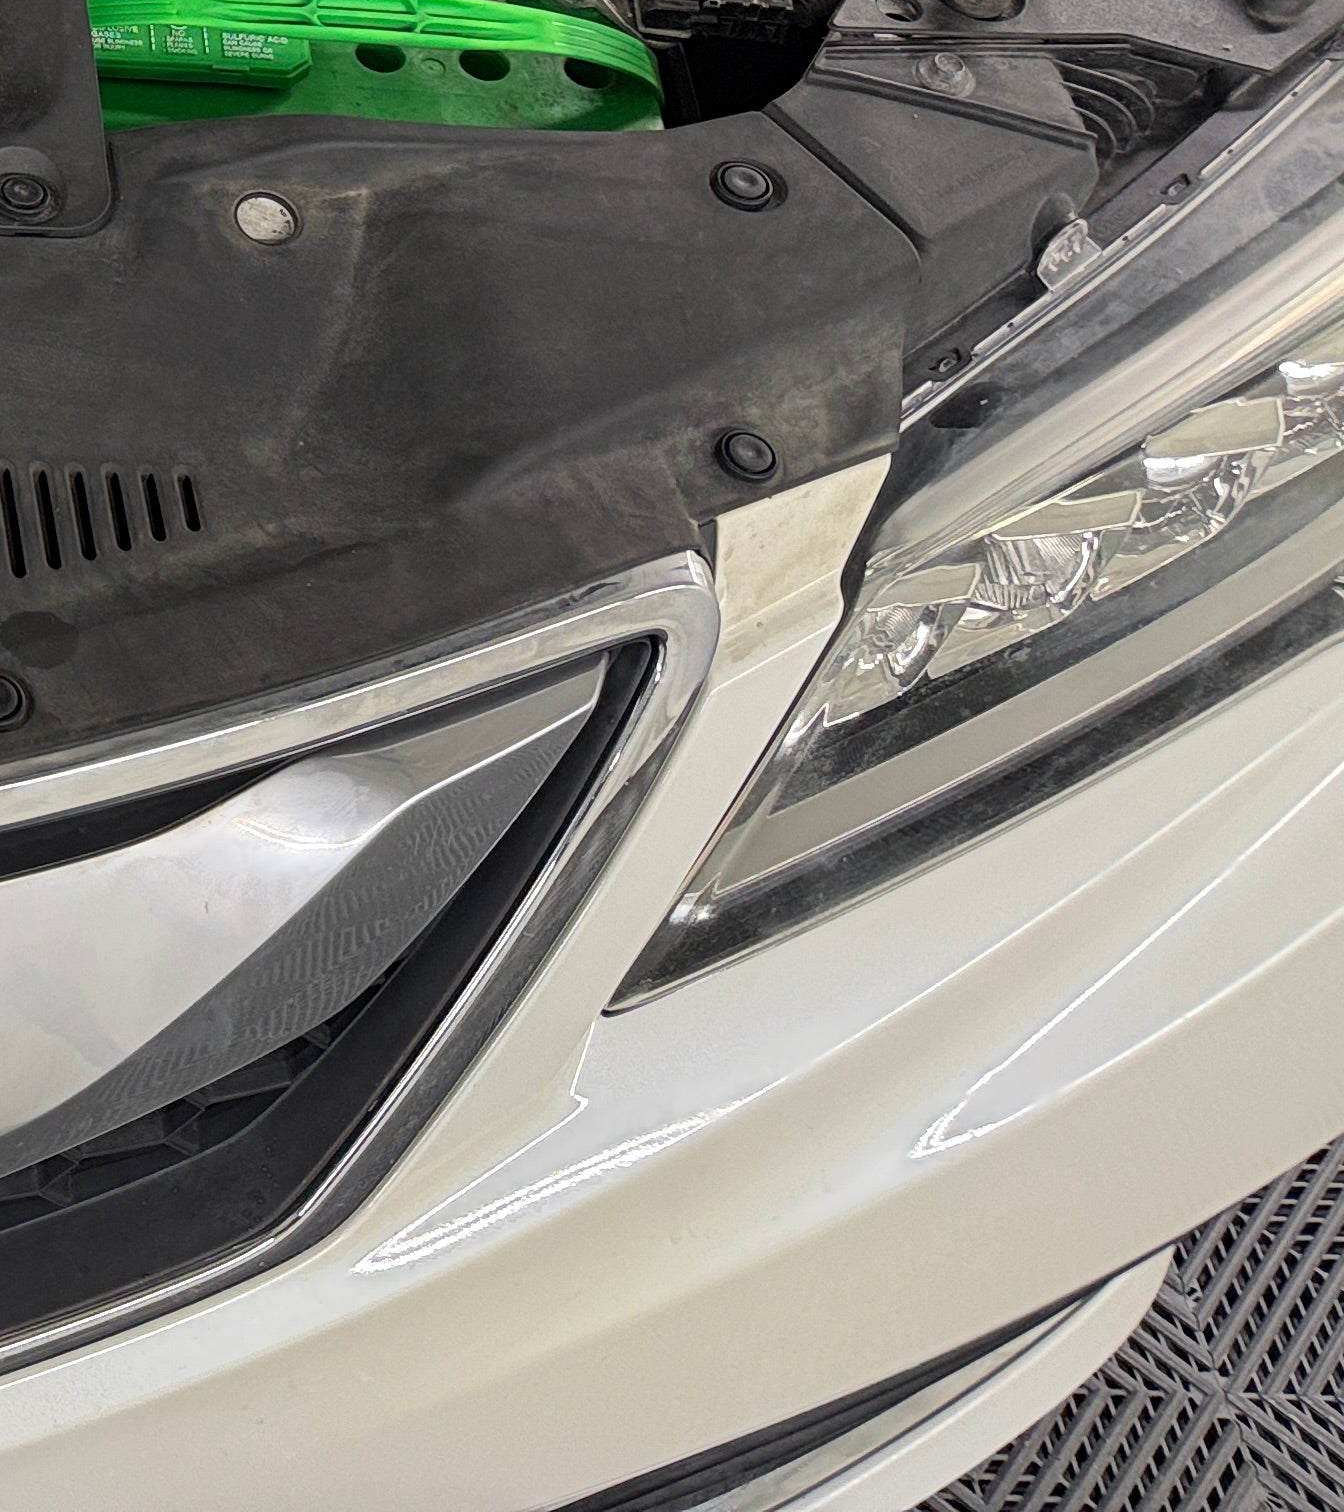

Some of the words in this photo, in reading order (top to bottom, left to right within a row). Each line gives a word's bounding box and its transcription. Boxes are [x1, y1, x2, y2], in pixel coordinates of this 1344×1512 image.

[172, 29, 186, 37] NO
[222, 32, 266, 43] SULFURIC
[266, 36, 289, 45] ACID
